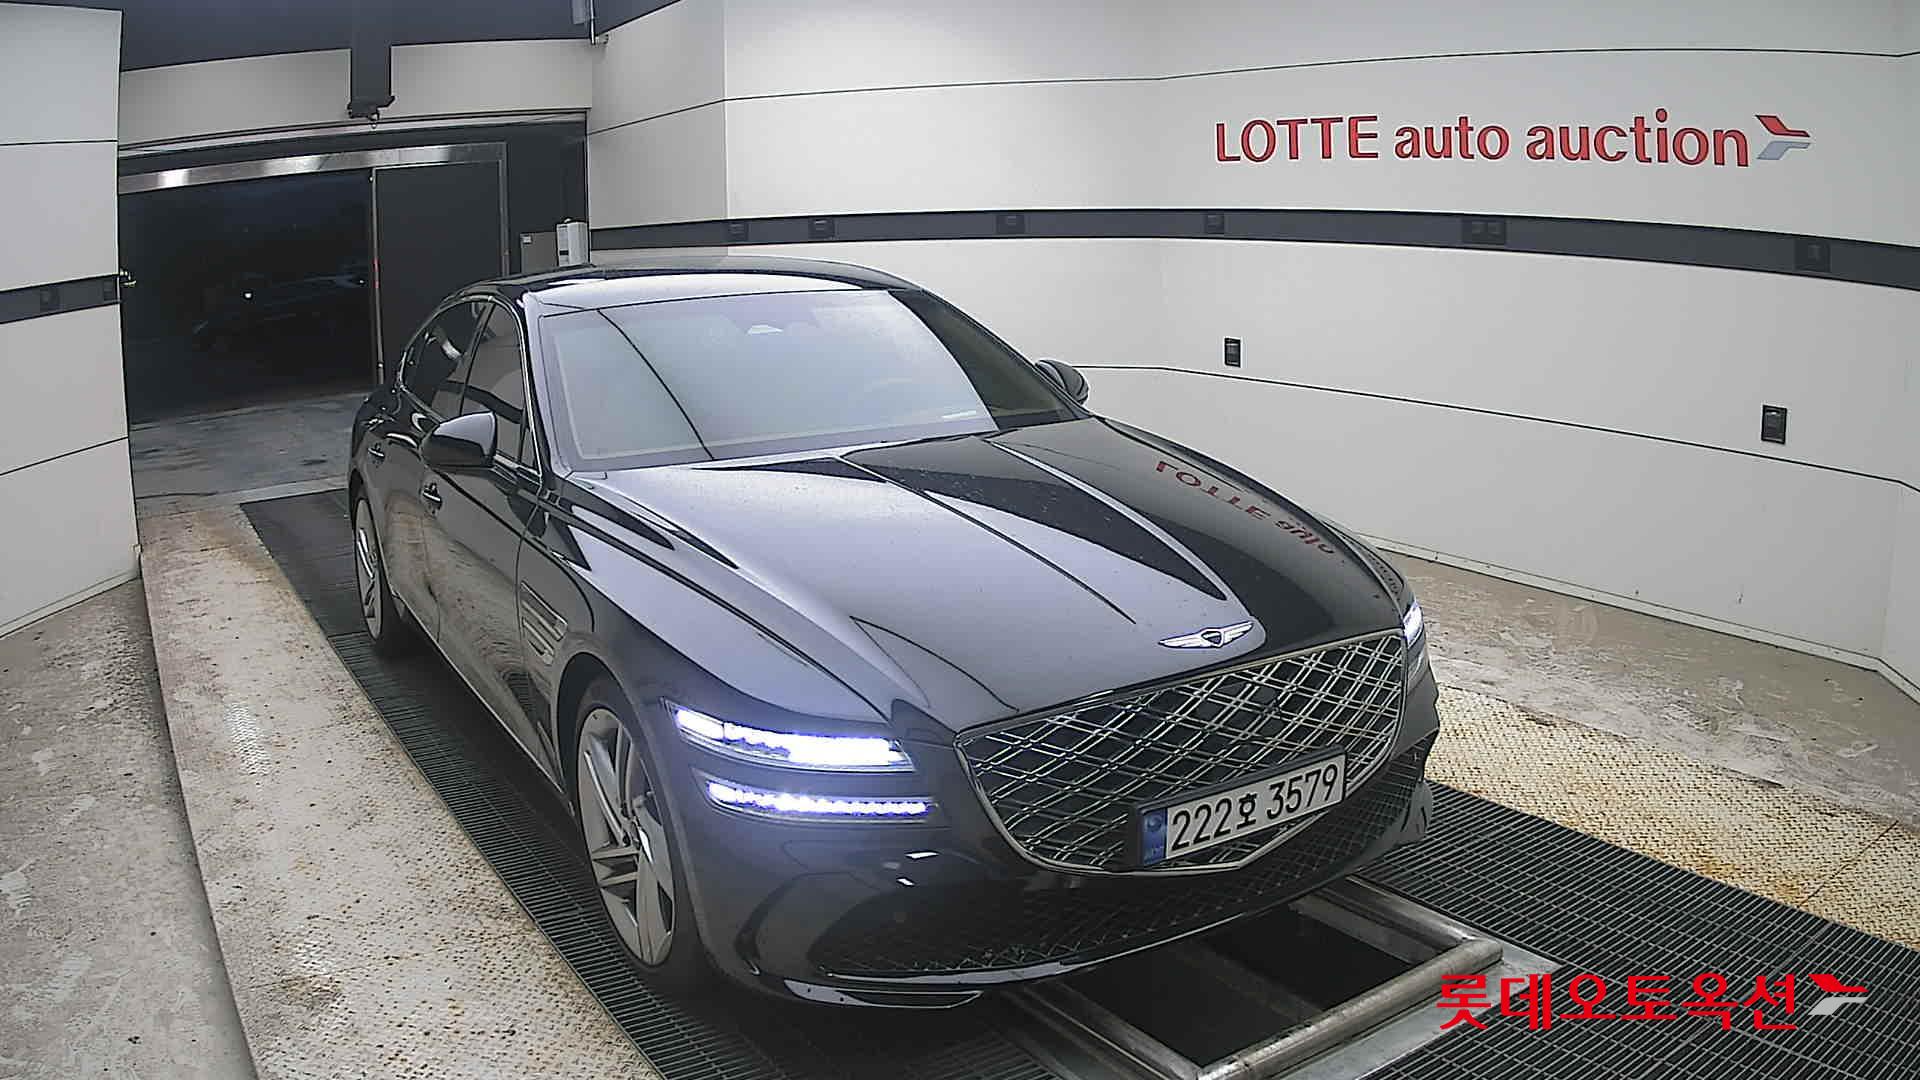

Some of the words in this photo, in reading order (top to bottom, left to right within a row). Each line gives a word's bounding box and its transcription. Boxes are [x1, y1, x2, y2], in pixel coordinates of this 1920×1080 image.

[1215, 115, 1379, 162] LOTTE
[1394, 115, 1511, 161] auto
[1525, 109, 1750, 168] auction
[1171, 792, 1258, 851] 222호
[1266, 763, 1339, 821] 3579
